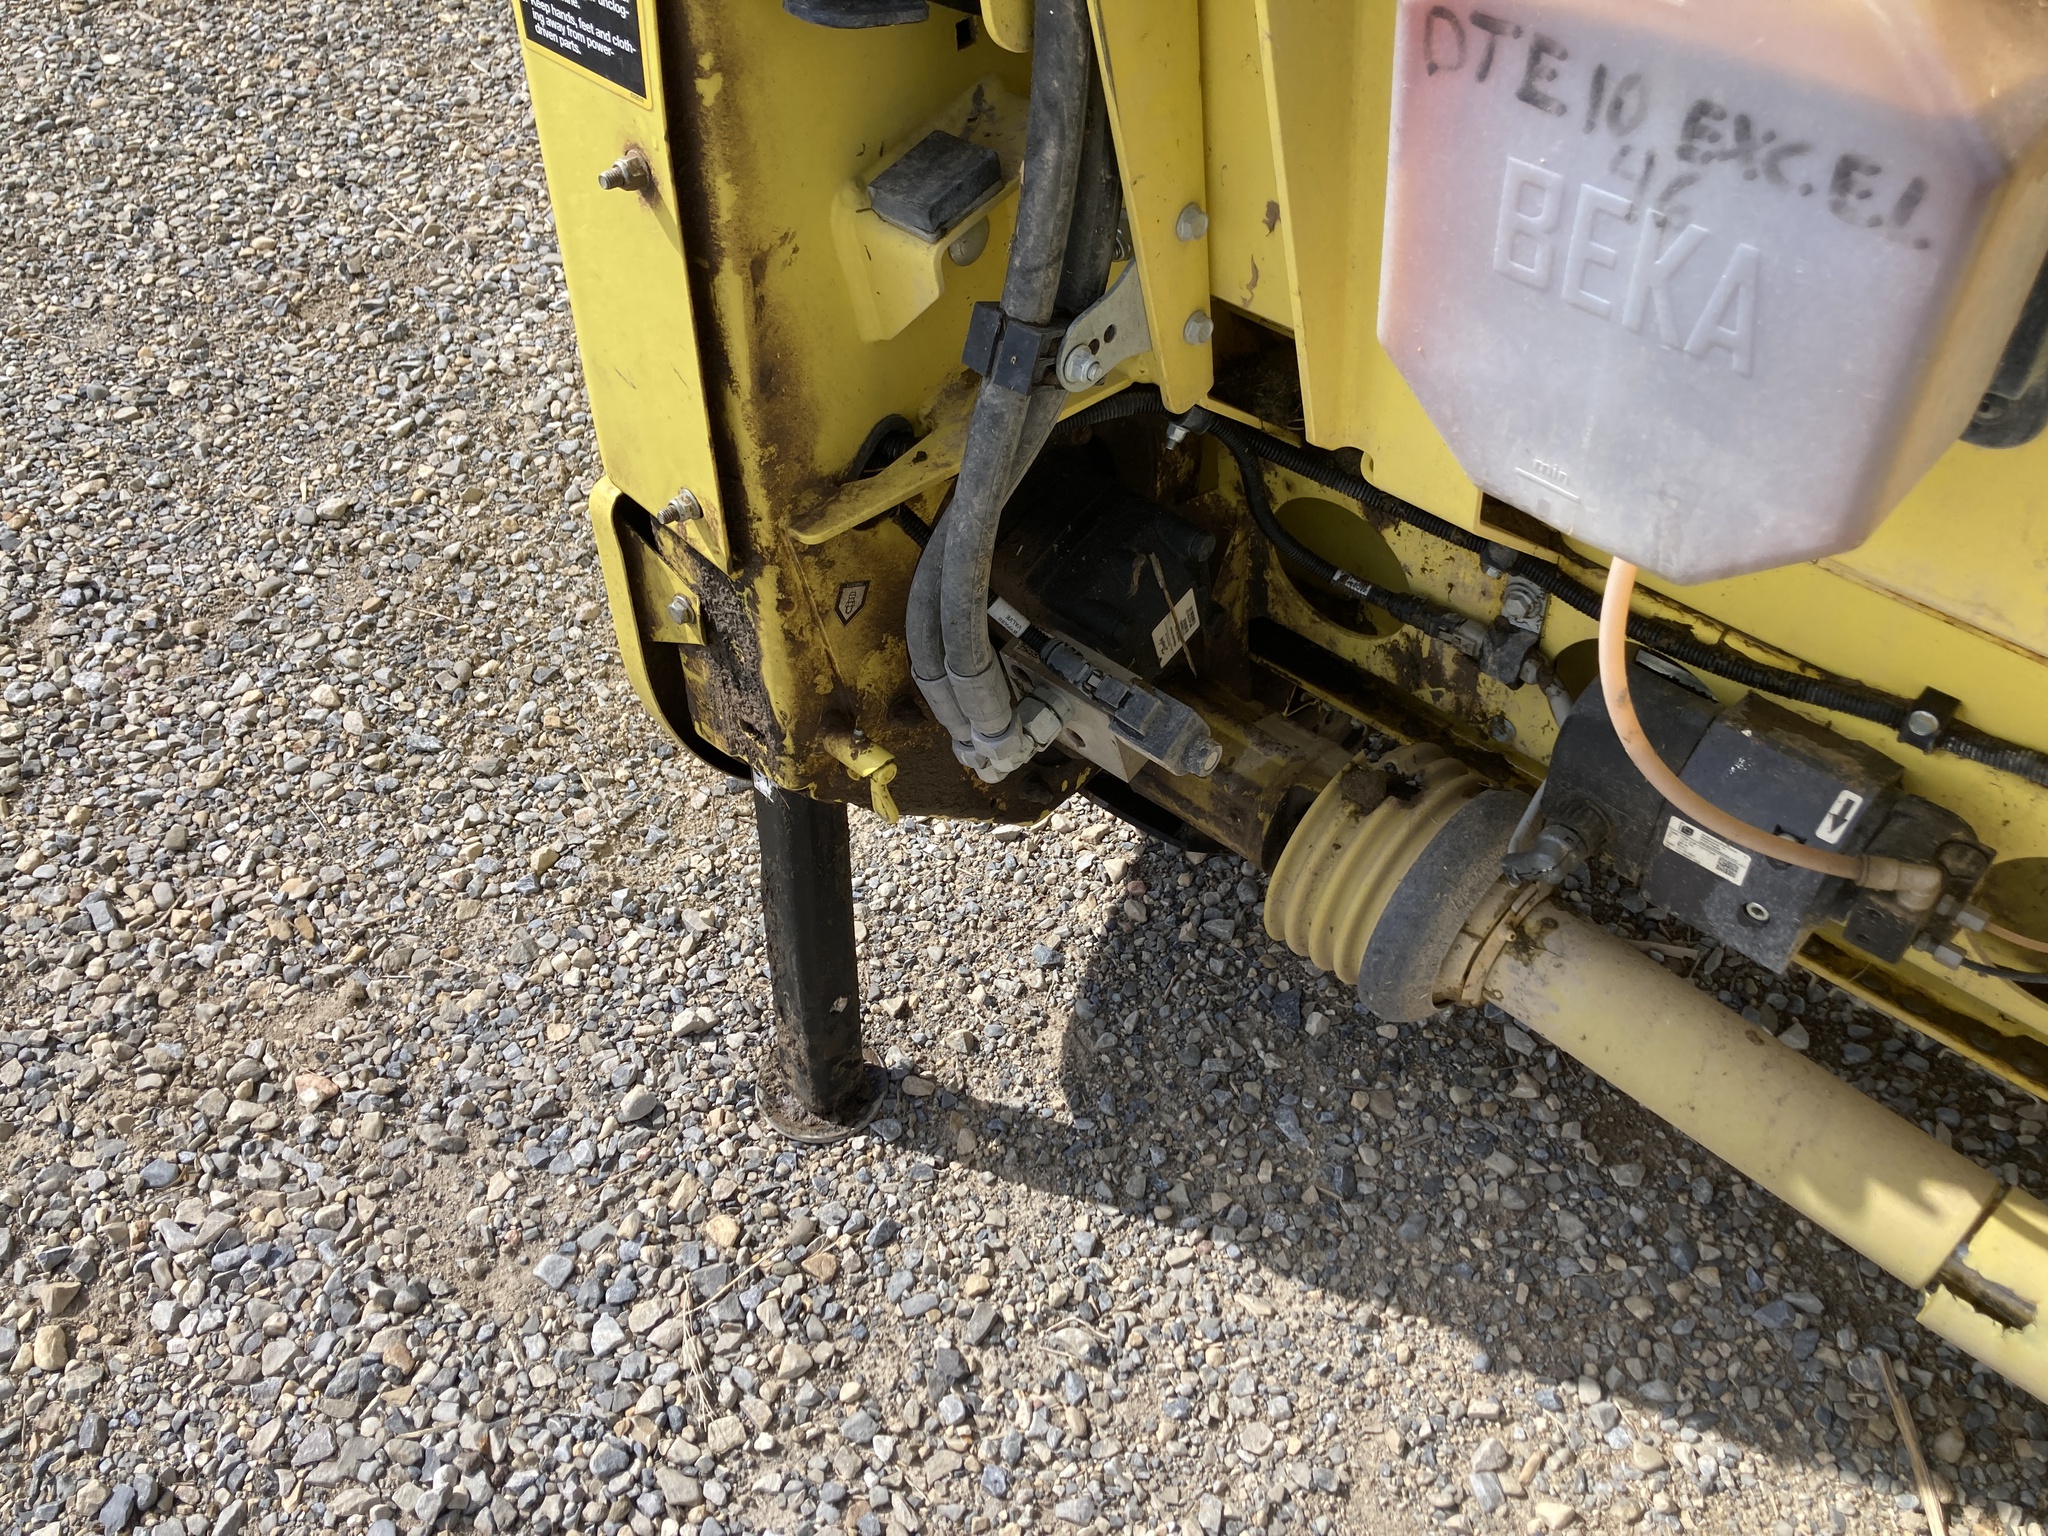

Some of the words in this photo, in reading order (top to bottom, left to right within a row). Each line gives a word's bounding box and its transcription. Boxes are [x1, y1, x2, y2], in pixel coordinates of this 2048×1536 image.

[531, 7, 546, 28] ing
[545, 17, 566, 36] away
[566, 24, 586, 44] from
[585, 36, 615, 57] power-
[534, 22, 559, 44] driven
[558, 36, 582, 55] parts.
[550, 3, 578, 29] hands,
[577, 16, 595, 36] feet
[594, 27, 612, 44] and
[611, 34, 637, 54] cloth-
[1422, 5, 1569, 117] DTE
[1493, 156, 1762, 378] BEKA
[1532, 458, 1570, 485] min
[1005, 614, 1022, 631] VALVE
